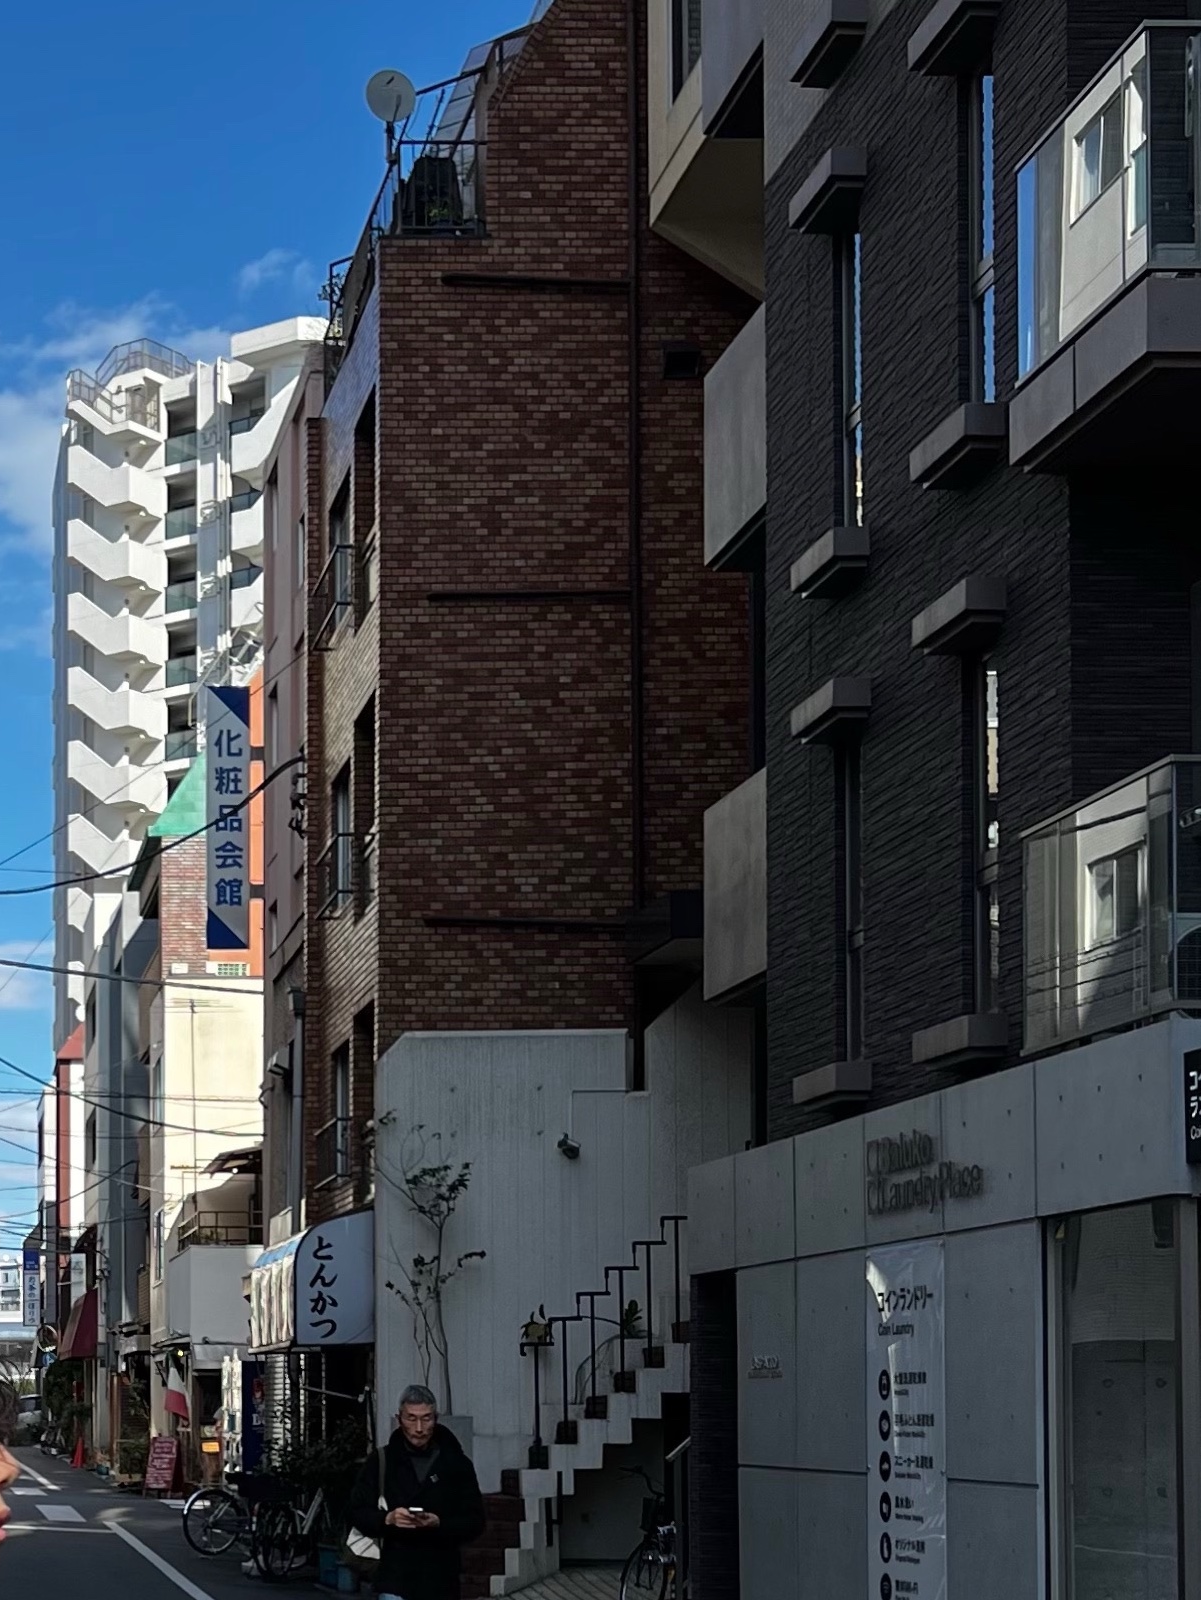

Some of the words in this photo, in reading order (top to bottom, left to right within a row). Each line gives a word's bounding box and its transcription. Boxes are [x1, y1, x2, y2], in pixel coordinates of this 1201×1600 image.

[214, 729, 244, 907] 化粧品会館
[1188, 1070, 1201, 1091] コ
[939, 1161, 984, 1199] Place
[308, 1236, 339, 1339] とんかつ
[877, 1285, 934, 1312] コインランドリー
[878, 1323, 891, 1336] Coin
[892, 1322, 915, 1338] Laundry
